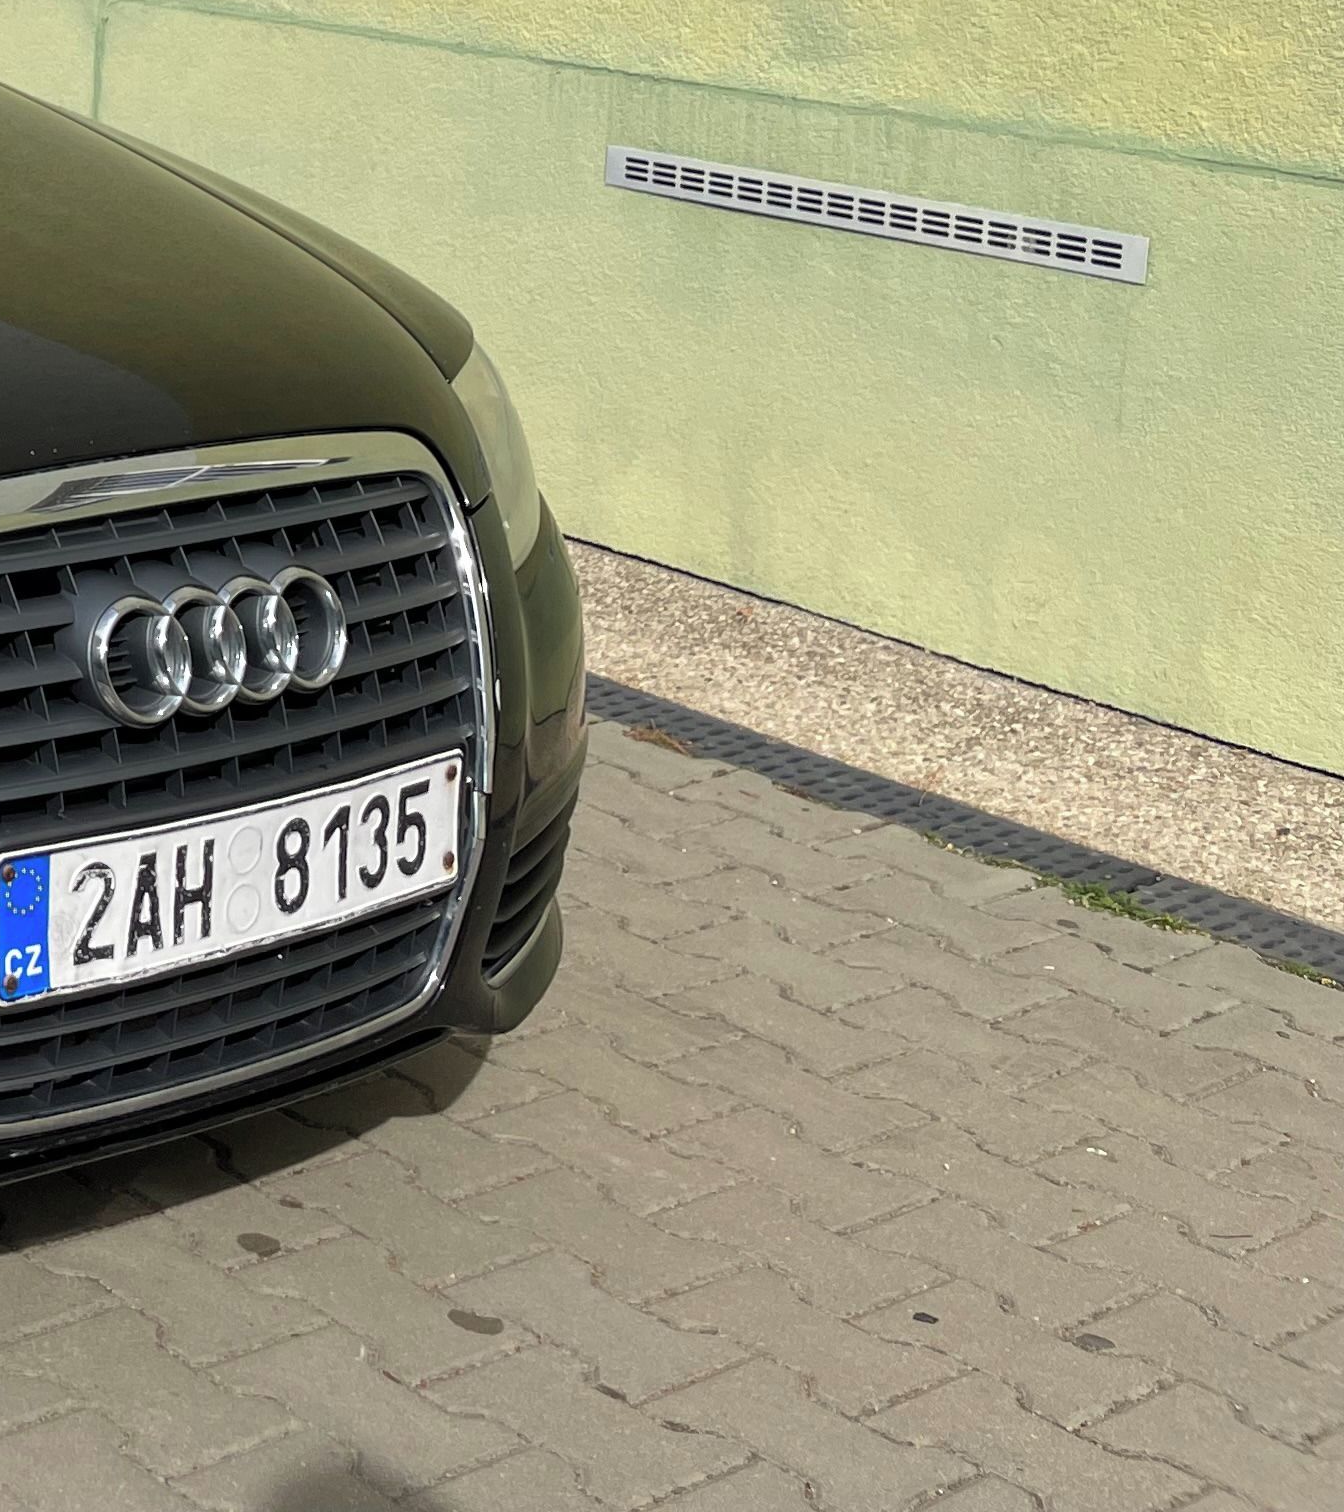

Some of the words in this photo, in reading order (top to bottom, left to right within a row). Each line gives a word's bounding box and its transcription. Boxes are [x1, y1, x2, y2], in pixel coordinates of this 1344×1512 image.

[71, 838, 216, 967] 2AH
[274, 778, 431, 915] 8135
[5, 943, 43, 979] CZ
